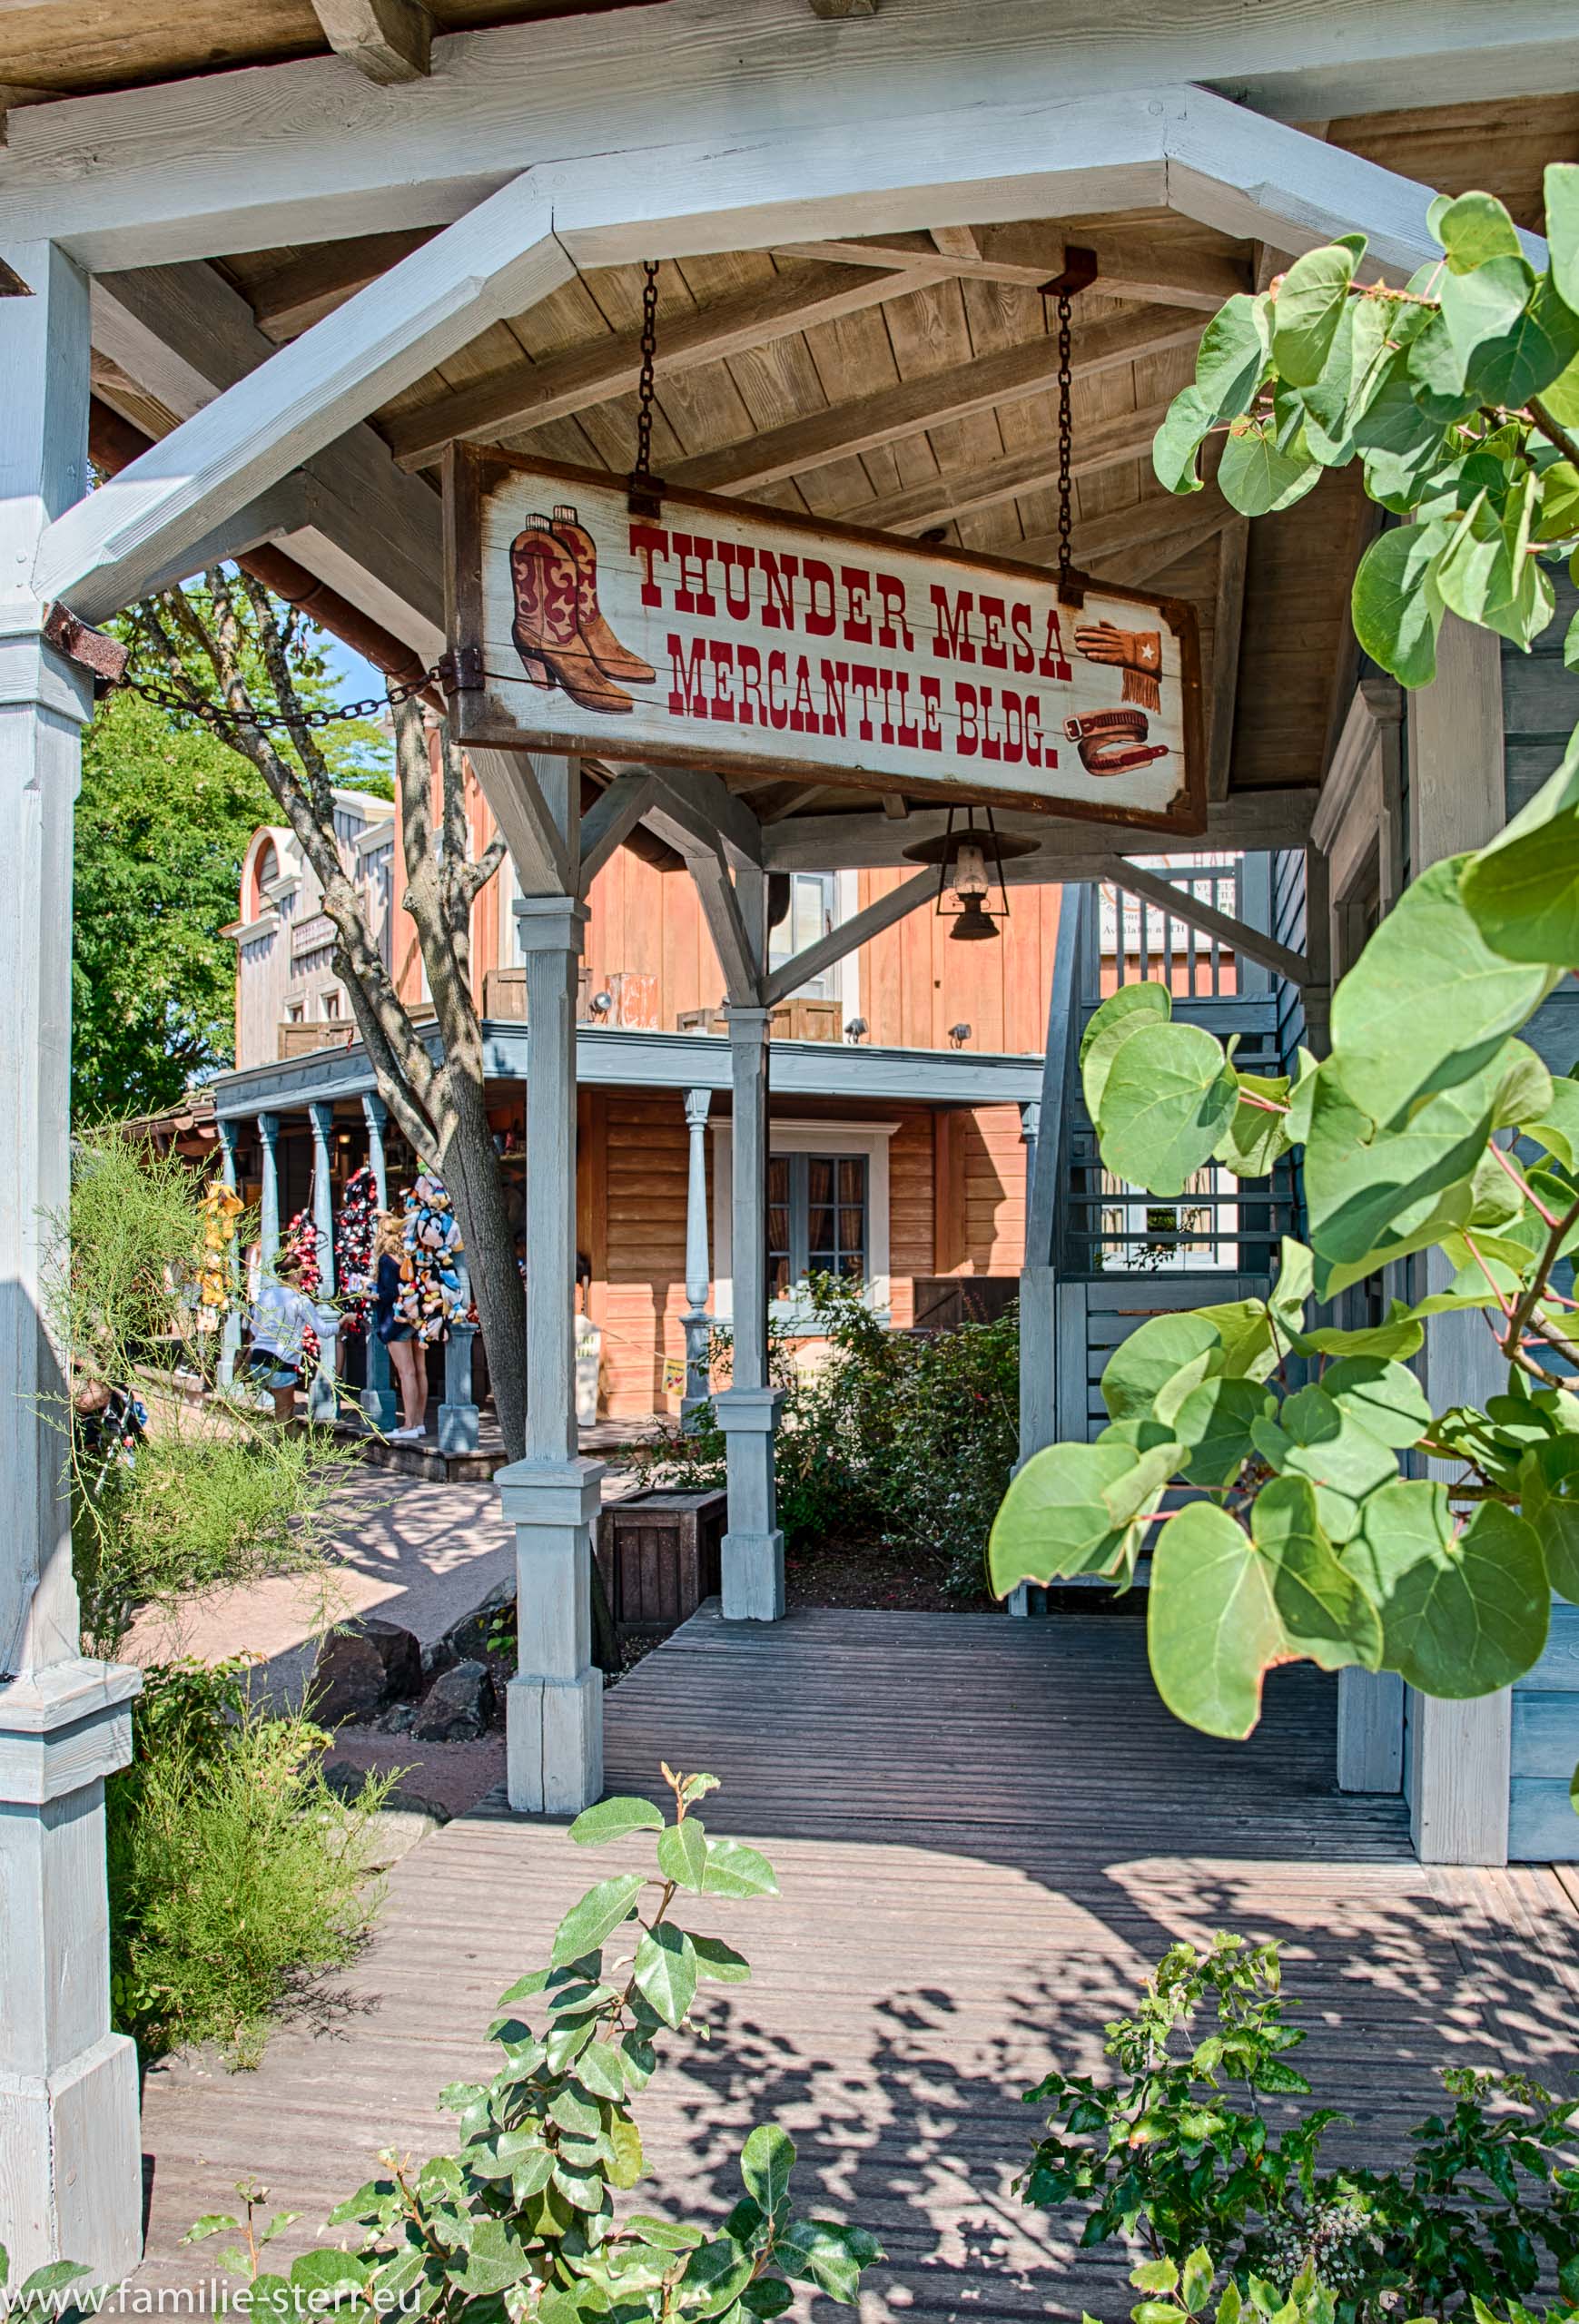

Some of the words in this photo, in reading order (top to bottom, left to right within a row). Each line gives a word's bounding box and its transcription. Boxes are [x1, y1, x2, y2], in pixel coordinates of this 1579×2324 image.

[629, 524, 913, 652] THUNDER
[930, 584, 1072, 682] MESA
[666, 633, 943, 753] MERCANTILE
[955, 682, 1059, 770] BLDG.
